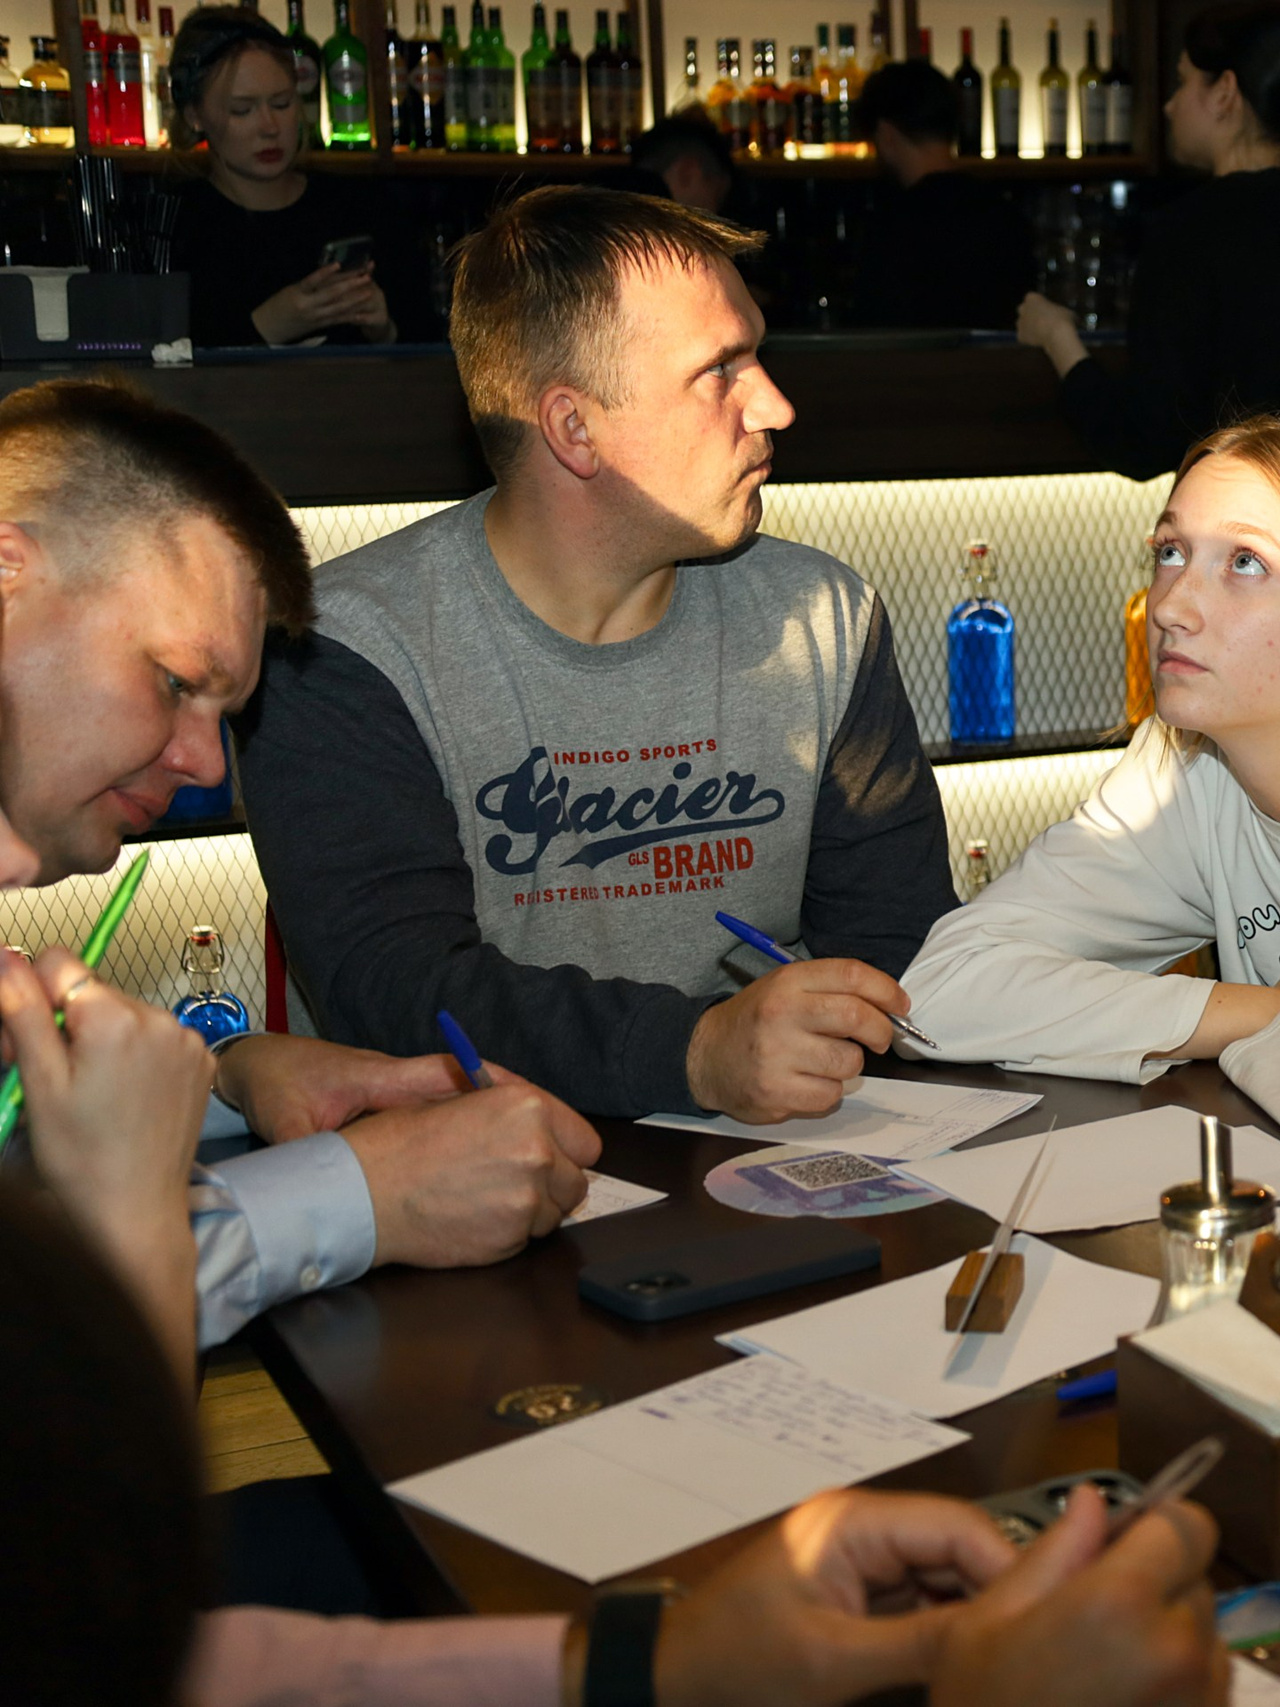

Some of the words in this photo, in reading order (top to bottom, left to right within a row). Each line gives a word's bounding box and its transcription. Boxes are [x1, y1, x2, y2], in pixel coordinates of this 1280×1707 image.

[552, 749, 630, 766] INDIGO
[640, 738, 717, 761] SPORTS
[474, 746, 785, 876] Glacier
[628, 851, 650, 866] GLS
[653, 837, 754, 879] BRAND
[603, 876, 725, 900] TRADEMARK
